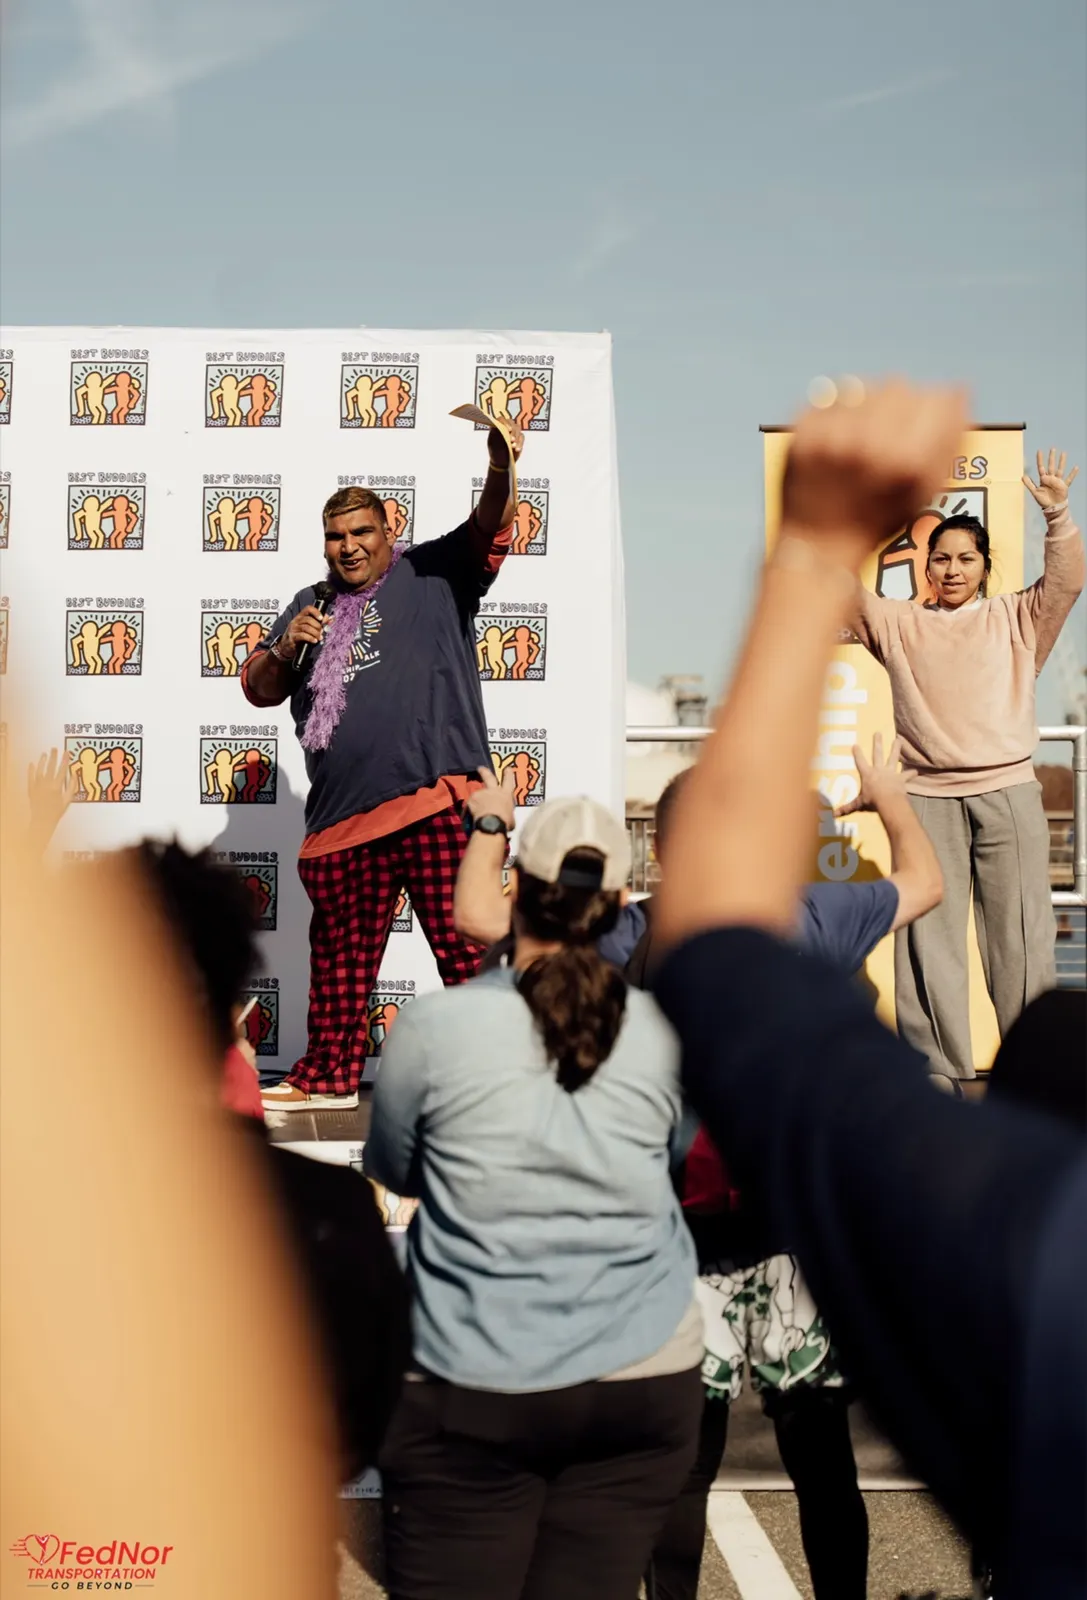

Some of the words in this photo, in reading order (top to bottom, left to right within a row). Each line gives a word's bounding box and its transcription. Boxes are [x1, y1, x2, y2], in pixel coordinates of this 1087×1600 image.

[71, 350, 97, 359] BEST
[101, 349, 149, 360] BUDDIES
[205, 352, 232, 362] BEST
[236, 352, 285, 362] BUDDIES
[341, 352, 368, 362] BEST
[371, 352, 420, 363] BUDDIES
[476, 354, 503, 364] BEST
[506, 354, 554, 366] BUDDIES
[68, 472, 96, 483] BEST
[98, 472, 146, 483] BUDDIES
[203, 474, 230, 484] BEST
[233, 474, 281, 485] BUDDIES
[337, 476, 364, 486] BEST
[368, 476, 416, 487] BUDDIES
[516, 478, 550, 489] DDIES
[66, 598, 93, 608] BEST
[96, 597, 144, 608] BUDDIES
[201, 599, 228, 609] BEST
[231, 599, 279, 610] BUDDIES
[500, 602, 548, 614] BUDDIES
[64, 724, 92, 734] BEST
[95, 724, 143, 735] BUDDIES
[200, 725, 227, 735] BEST
[229, 725, 278, 736] BUDDIES
[499, 728, 547, 739] BUDDIES
[810, 661, 868, 882] ership
[229, 851, 278, 863] BUDDIES
[251, 978, 279, 989] DIES
[376, 980, 415, 991] UDDIES
